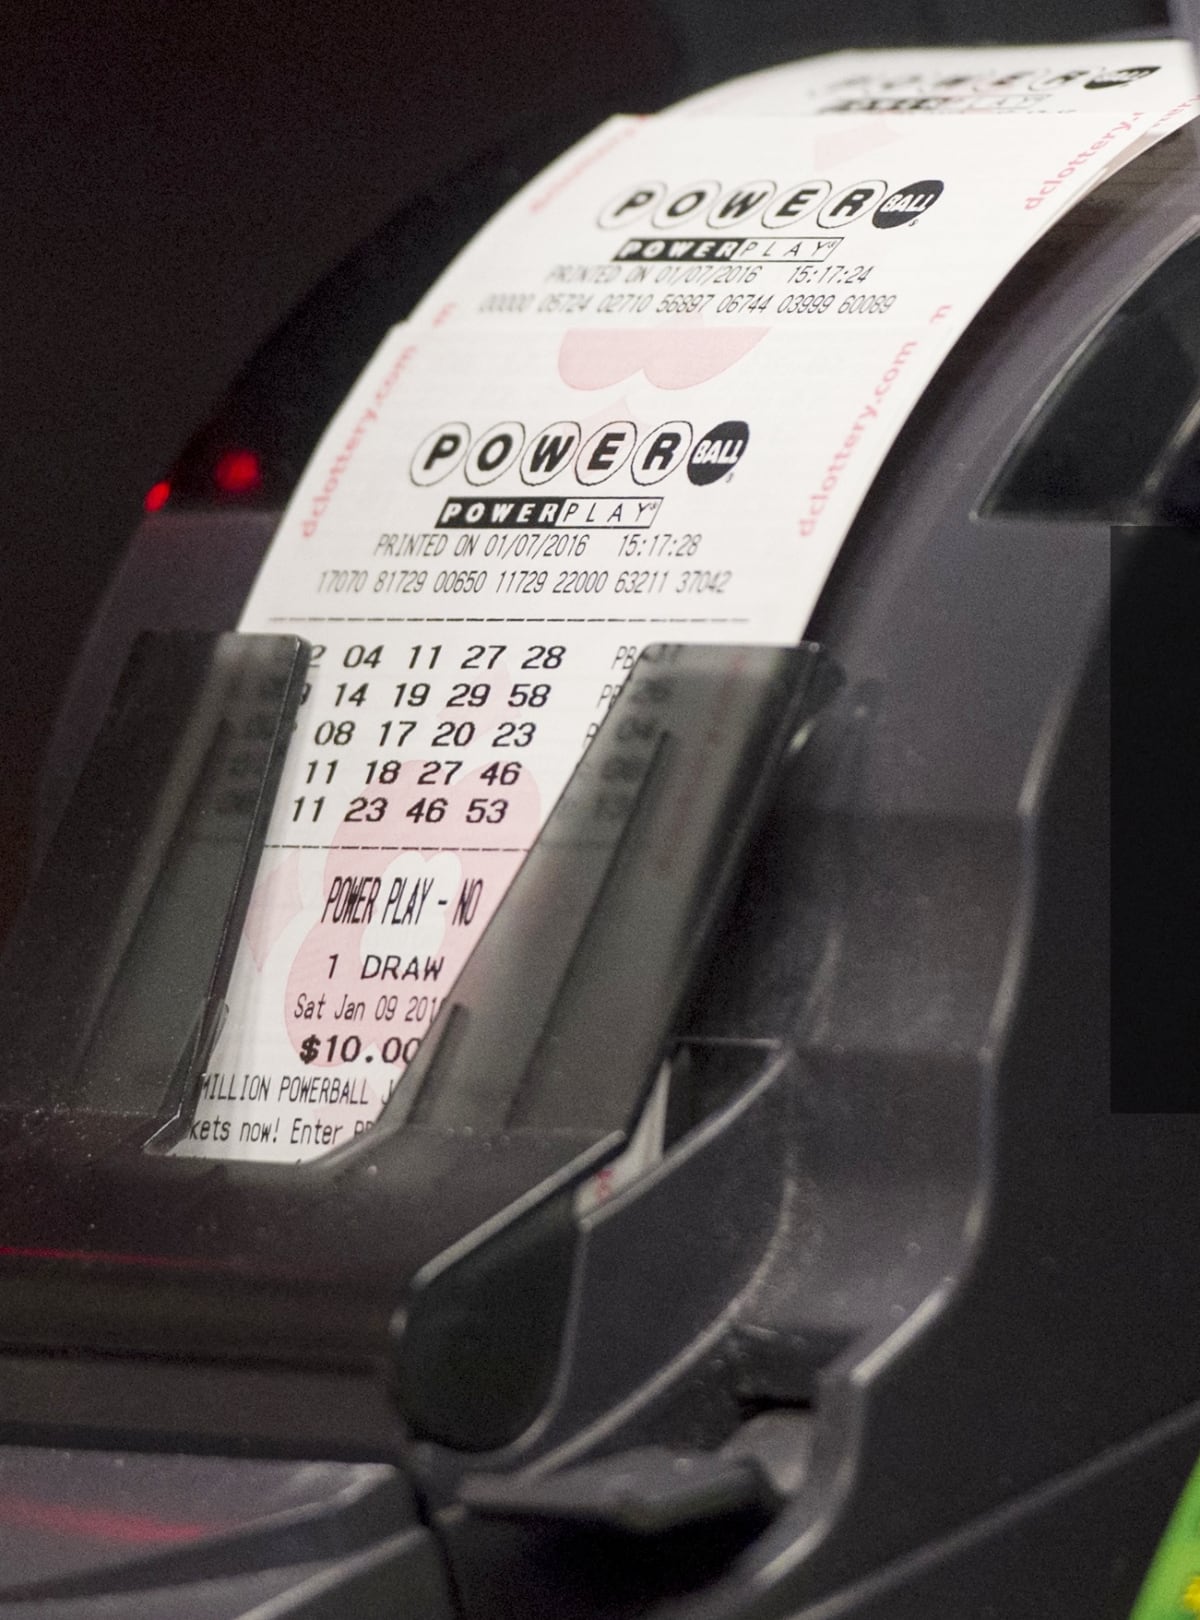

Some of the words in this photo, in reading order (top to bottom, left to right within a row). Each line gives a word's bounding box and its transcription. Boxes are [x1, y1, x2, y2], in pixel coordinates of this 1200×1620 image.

[654, 264, 763, 285] 01/07/2016
[787, 264, 874, 284] 15:17:24
[716, 294, 775, 314] 06744
[777, 294, 836, 314] 03999
[798, 340, 918, 537] dclottery.com
[373, 533, 448, 557] PRINTED
[453, 533, 480, 557] ON
[484, 533, 590, 560] 01/07/2016
[618, 533, 702, 557] 15:17:28
[317, 569, 368, 594] 17070
[373, 570, 428, 594] 81729
[433, 570, 487, 594] 00650
[496, 570, 548, 593] 11729
[552, 570, 609, 593] 22000
[614, 570, 668, 593] 63211
[676, 570, 732, 593] 37042
[343, 645, 384, 669] 04
[409, 645, 442, 669] 11
[460, 645, 507, 669] 27
[521, 645, 566, 669] 28
[335, 683, 369, 707] 14
[394, 683, 431, 708] 19
[446, 683, 491, 708] 29
[508, 684, 551, 708] 58
[314, 720, 356, 746] 08
[379, 721, 417, 747] 17
[431, 721, 476, 747] 20
[492, 722, 536, 747] 23
[306, 760, 338, 784] 11
[365, 760, 402, 785] 18
[417, 760, 463, 785] 27
[480, 761, 522, 786] 46
[293, 796, 325, 822] 11
[344, 797, 388, 822] 23
[406, 797, 448, 823] 46
[466, 798, 508, 824] 53
[321, 876, 381, 924] POWER
[381, 877, 434, 925] PLAY
[452, 878, 483, 926] NO
[328, 954, 340, 979] 1
[360, 955, 444, 981] DRAW
[294, 993, 326, 1020] Sat
[334, 994, 365, 1021] Jan
[375, 995, 398, 1022] 09
[405, 996, 443, 1024] 201
[299, 1034, 420, 1065] $10.00
[278, 1076, 368, 1105] POWERBALL
[240, 1117, 280, 1144] now!
[290, 1118, 343, 1145] Enter
